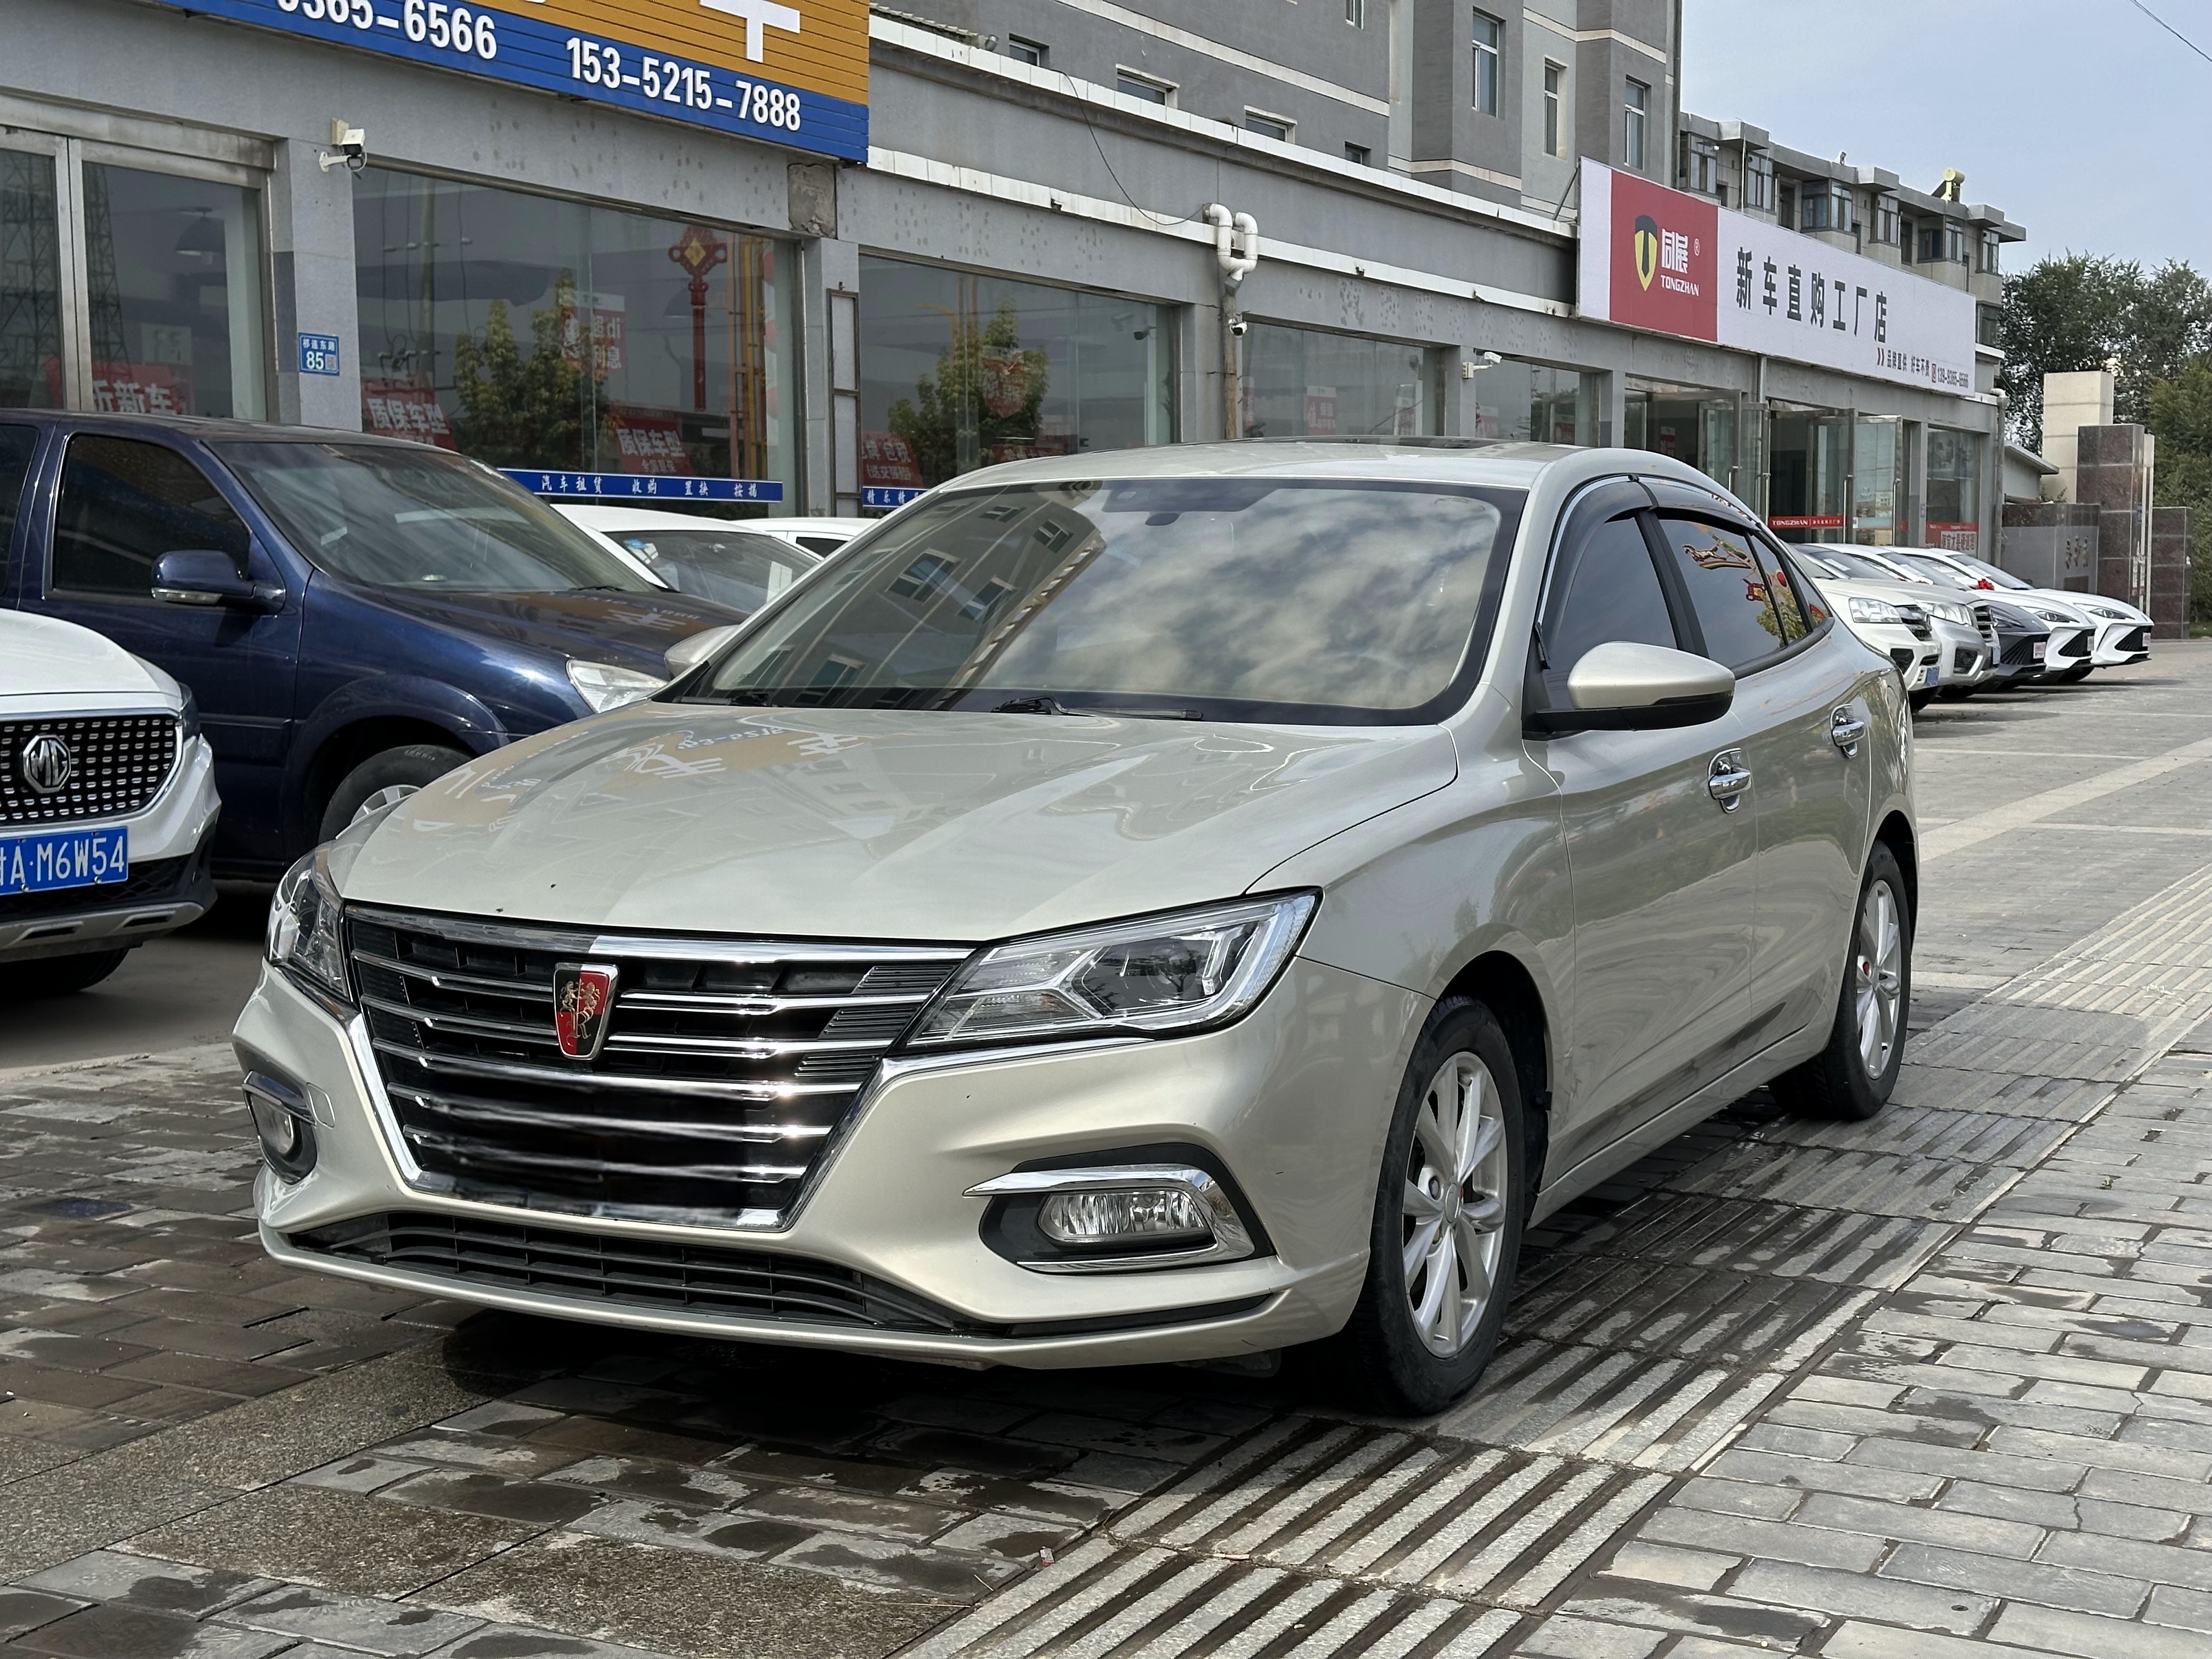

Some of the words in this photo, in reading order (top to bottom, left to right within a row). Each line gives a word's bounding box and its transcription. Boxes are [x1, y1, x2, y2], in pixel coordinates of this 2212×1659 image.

[566, 37, 801, 131] 153-5215-7888
[1660, 274, 1700, 297] TONGZHAN
[1736, 246, 1887, 343] 新车直购工厂店
[306, 351, 324, 370] 85
[366, 398, 450, 435] 质保车型
[616, 428, 686, 457] 质保车型
[541, 474, 603, 494] 汽车租赁
[631, 478, 657, 495] 收购
[30, 739, 69, 787] MG
[0, 836, 125, 886] A·M6W54
